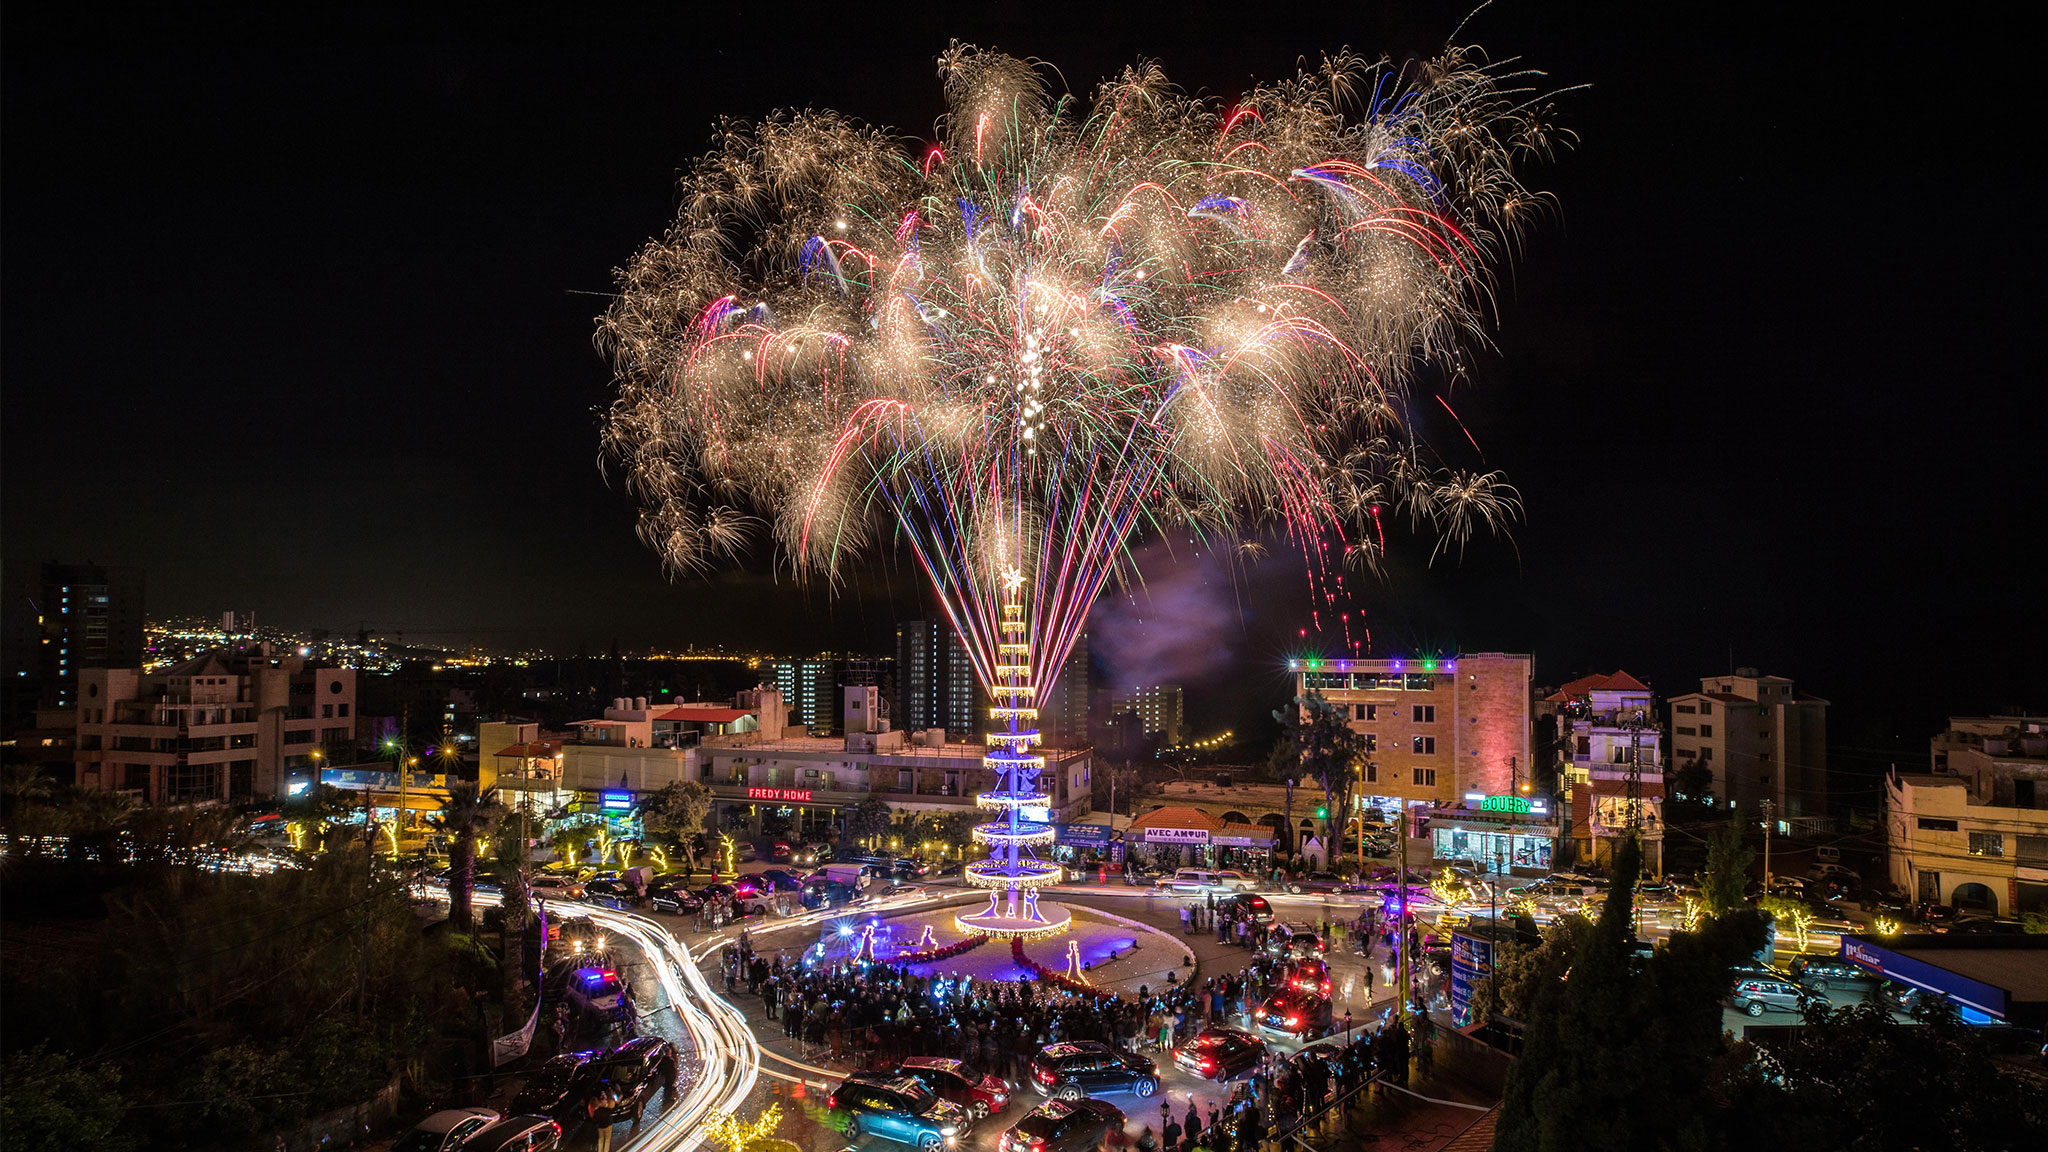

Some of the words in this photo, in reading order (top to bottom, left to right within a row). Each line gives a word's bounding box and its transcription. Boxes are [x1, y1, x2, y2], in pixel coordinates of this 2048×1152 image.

[749, 788, 780, 799] FREDY
[783, 790, 812, 801] HOME
[1147, 829, 1171, 837] AVEC
